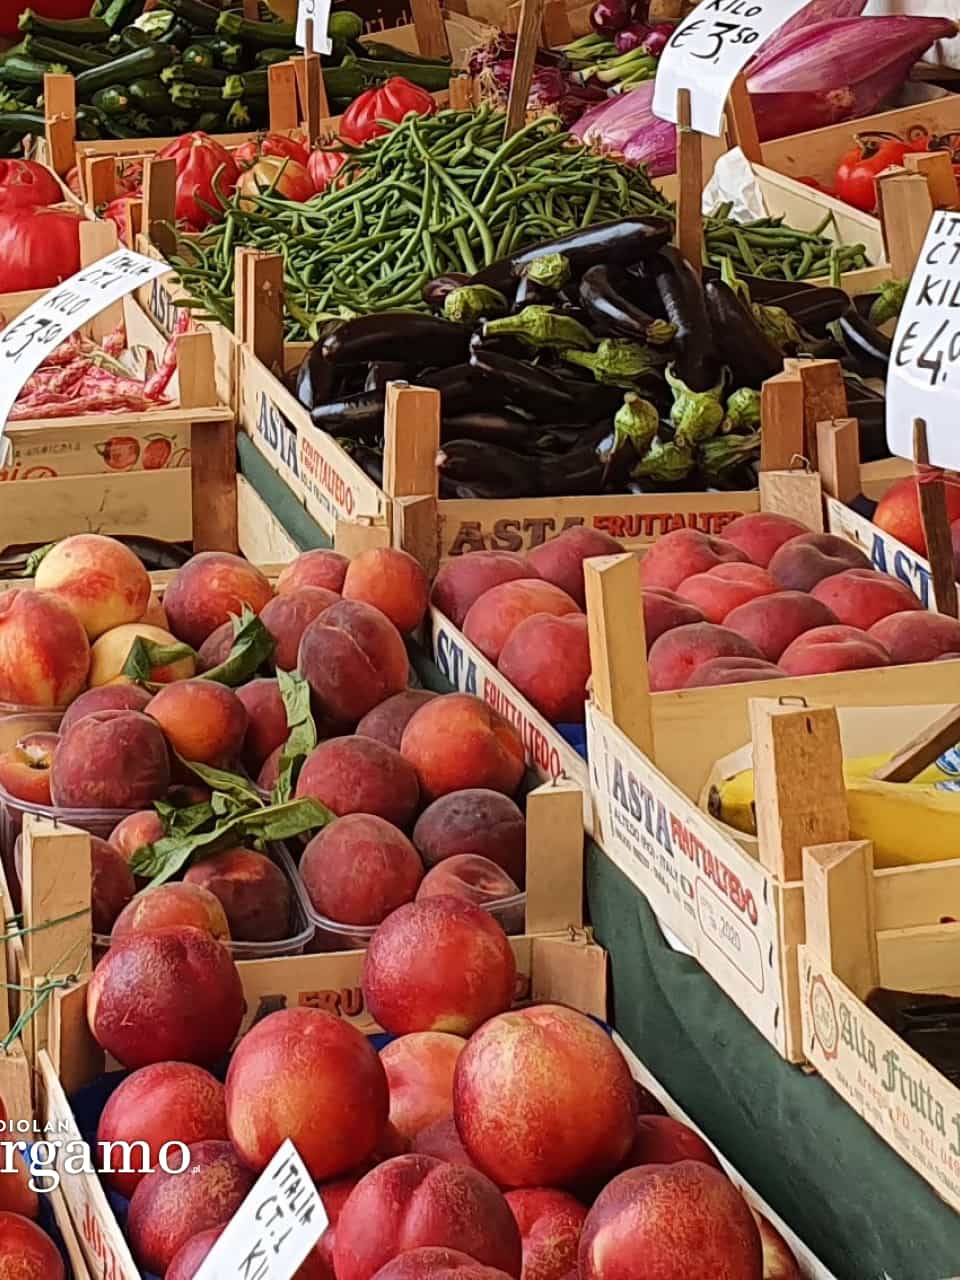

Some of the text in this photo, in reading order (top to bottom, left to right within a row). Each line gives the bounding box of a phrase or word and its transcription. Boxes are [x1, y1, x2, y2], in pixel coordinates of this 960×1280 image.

[43, 289, 91, 316] KILO
[256, 391, 300, 480] ASTA
[872, 532, 933, 610] AST
[612, 756, 675, 858] ASTA
[839, 1000, 878, 1074] Alta
[881, 1047, 947, 1137] Frutta
[272, 1152, 316, 1226] ITALIA
